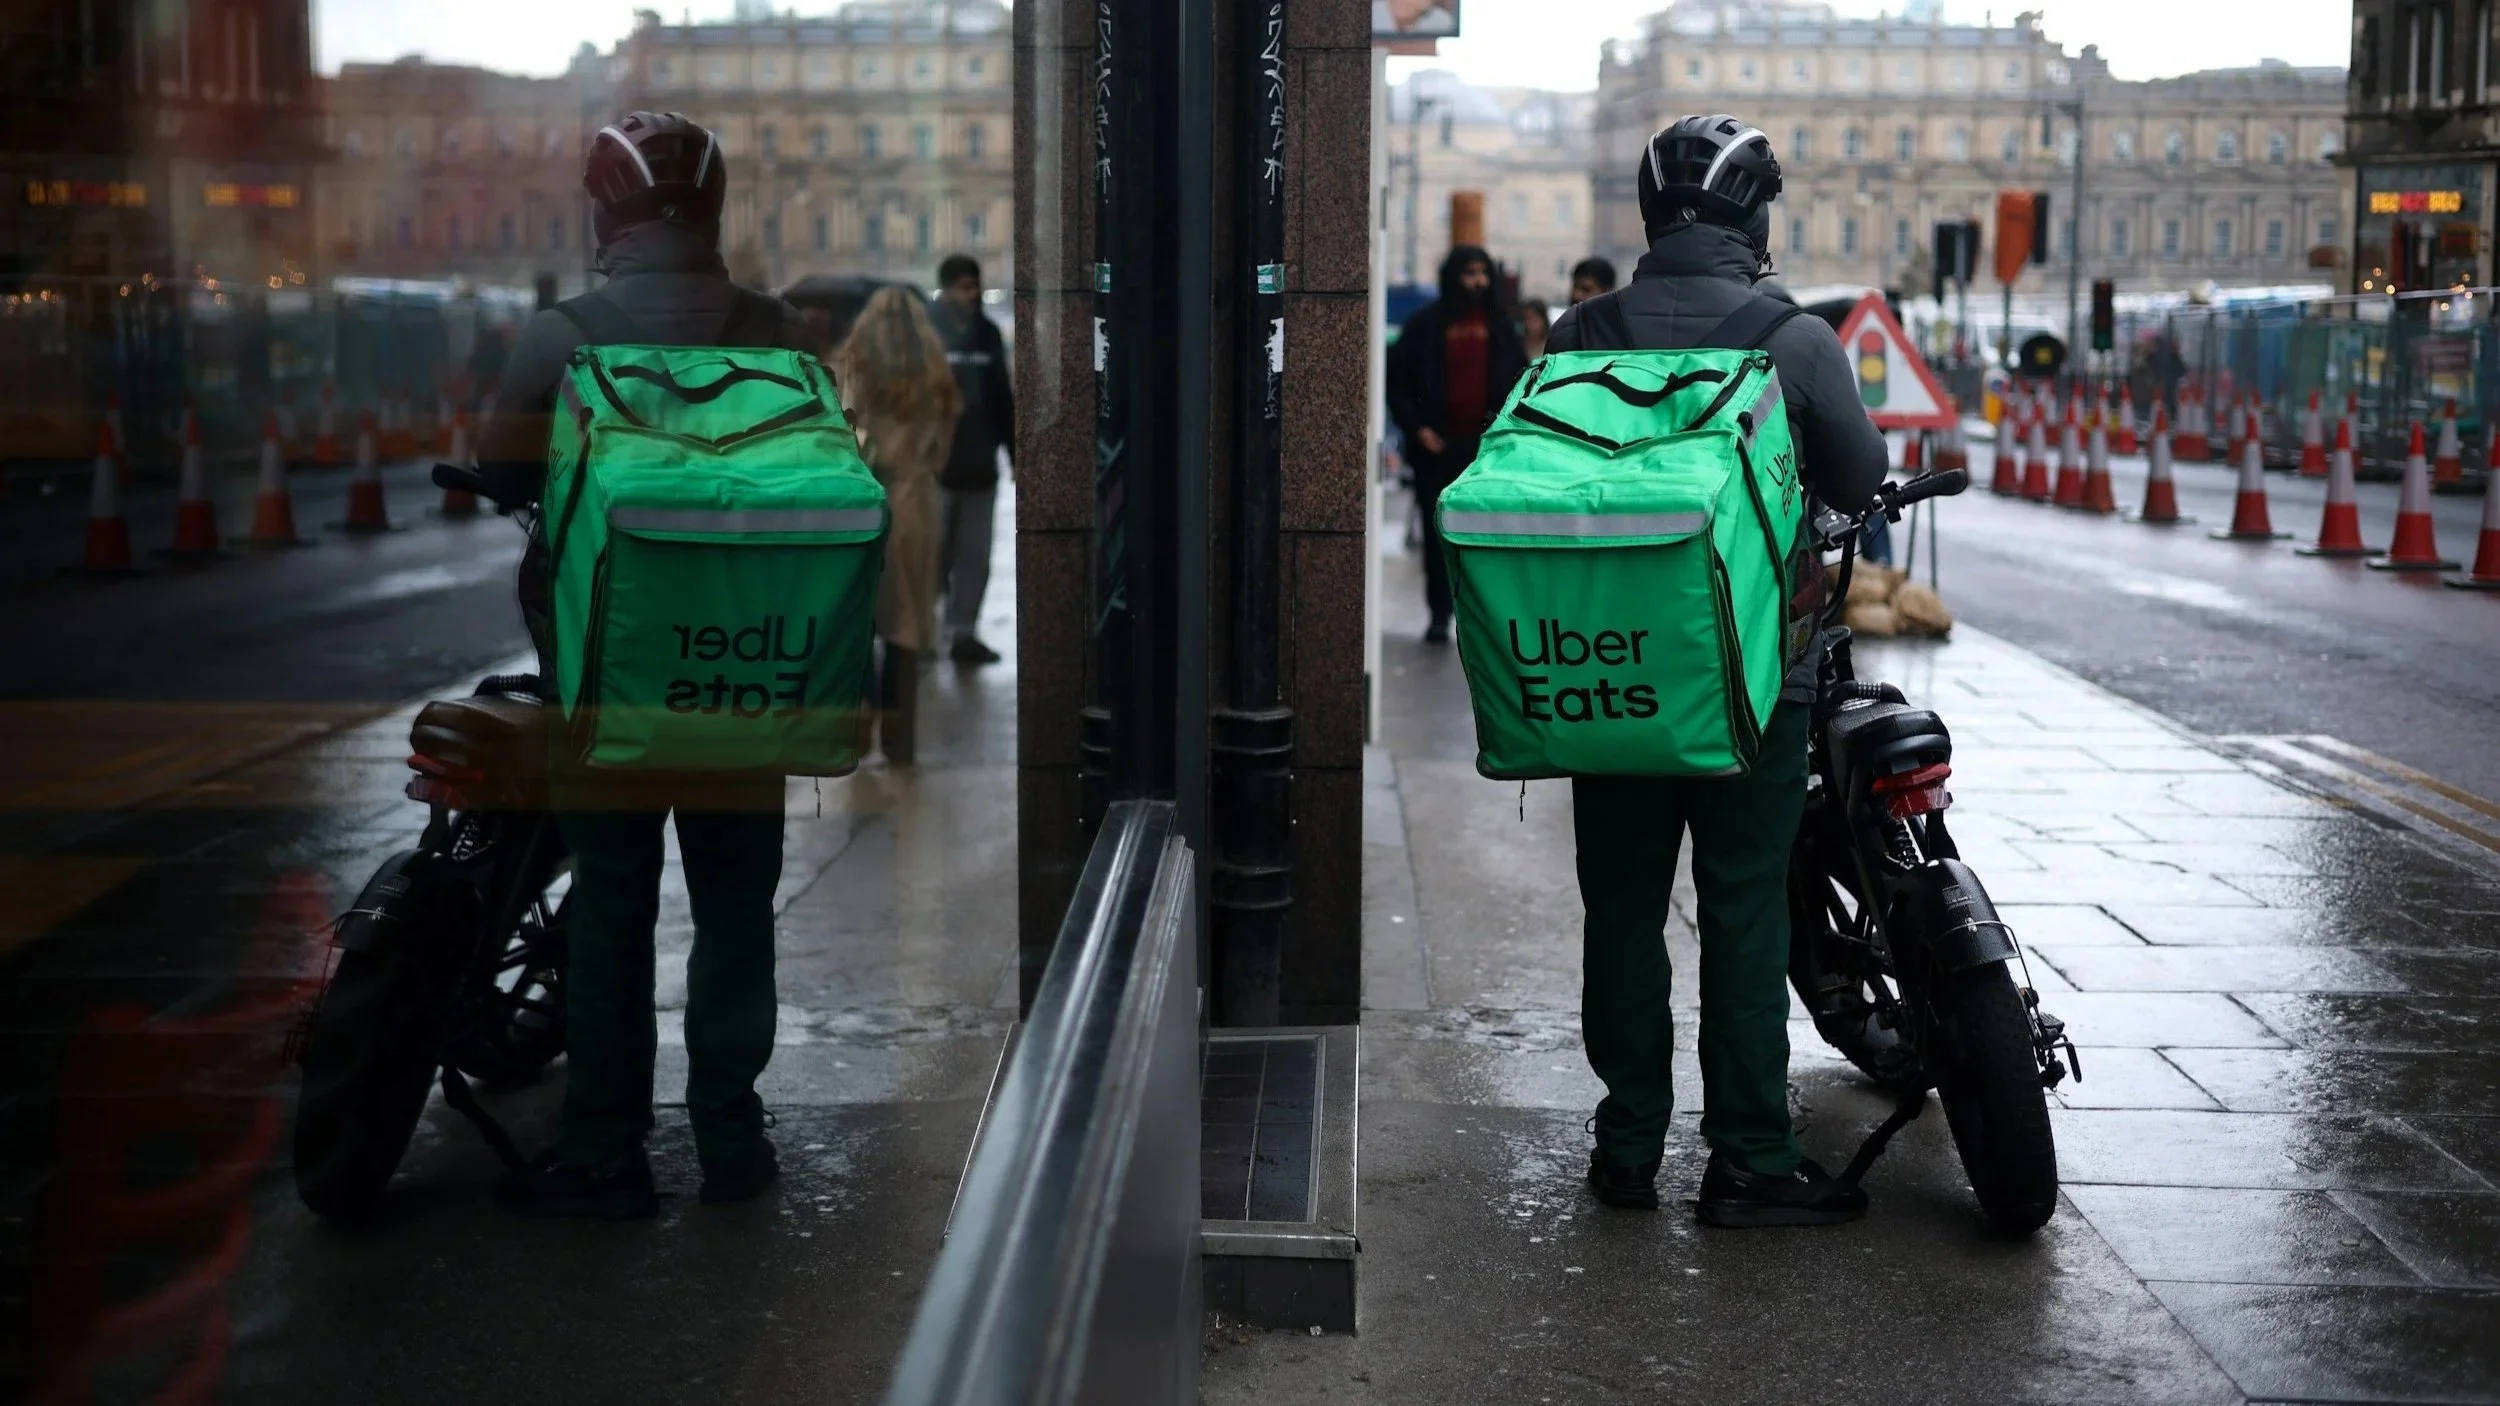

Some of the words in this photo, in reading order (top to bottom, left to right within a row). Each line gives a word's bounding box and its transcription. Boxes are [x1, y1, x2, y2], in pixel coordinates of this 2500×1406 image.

[1765, 443, 1793, 487] Ube
[1508, 618, 1649, 668] Uber
[1518, 675, 1660, 723] Eats
